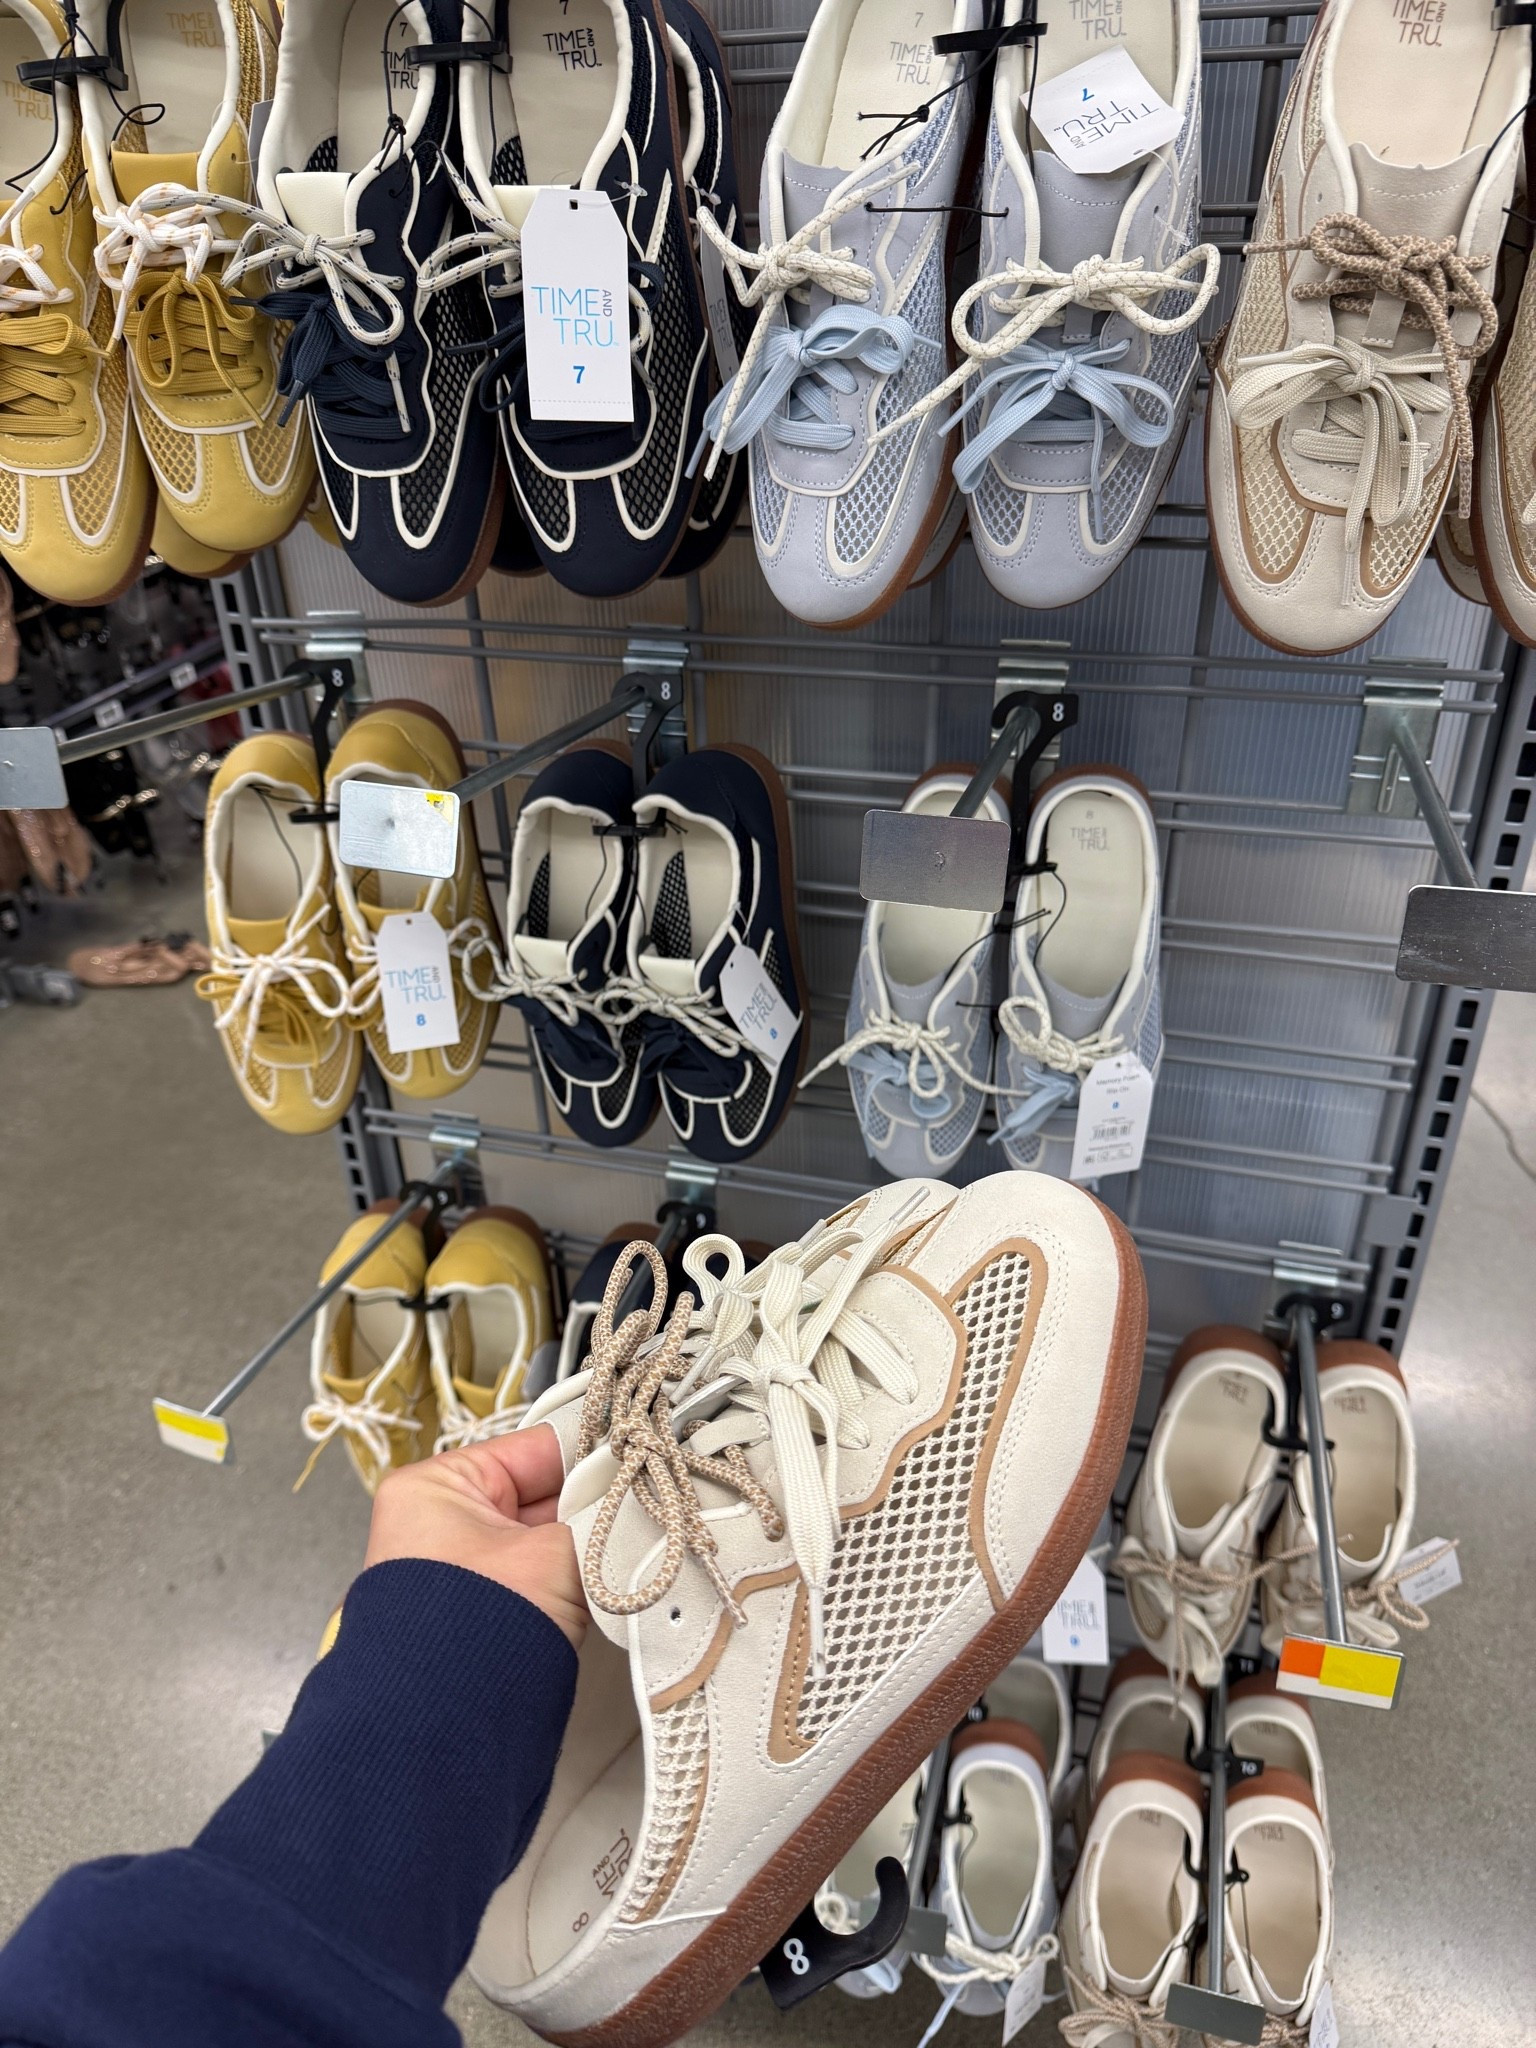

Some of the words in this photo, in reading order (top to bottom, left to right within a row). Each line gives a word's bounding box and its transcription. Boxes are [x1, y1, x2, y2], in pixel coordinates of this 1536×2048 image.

[560, 0, 568, 15] 7
[1069, 0, 1114, 20] TIME
[165, 12, 208, 30] TIME
[400, 22, 408, 37] 7
[916, 12, 924, 28] 7
[1081, 16, 1122, 40] TRU
[181, 30, 217, 48] TRU
[543, 28, 587, 52] TIME
[586, 27, 595, 47] AND
[1399, 21, 1441, 46] TRU
[558, 48, 597, 71] TRU
[890, 41, 927, 64] TIME
[896, 63, 929, 85] TRU
[1082, 88, 1094, 101] 7
[14, 99, 49, 120] TRU
[1062, 100, 1128, 138] TRU
[1082, 103, 1159, 144] TIME
[1070, 135, 1086, 149] AND
[531, 286, 601, 316] TIME
[602, 289, 613, 317] AND
[553, 318, 613, 347] TRU
[573, 365, 585, 384] 7
[332, 667, 344, 688] 8
[661, 681, 671, 700] 8
[1052, 702, 1064, 722] 8
[384, 966, 432, 988] TIME
[401, 984, 442, 1005] TRU
[739, 985, 764, 1028] TIME
[416, 1013, 426, 1027] 8
[593, 1855, 610, 1878] AND
[572, 1912, 589, 1932] 8
[783, 1938, 809, 1975] 8
